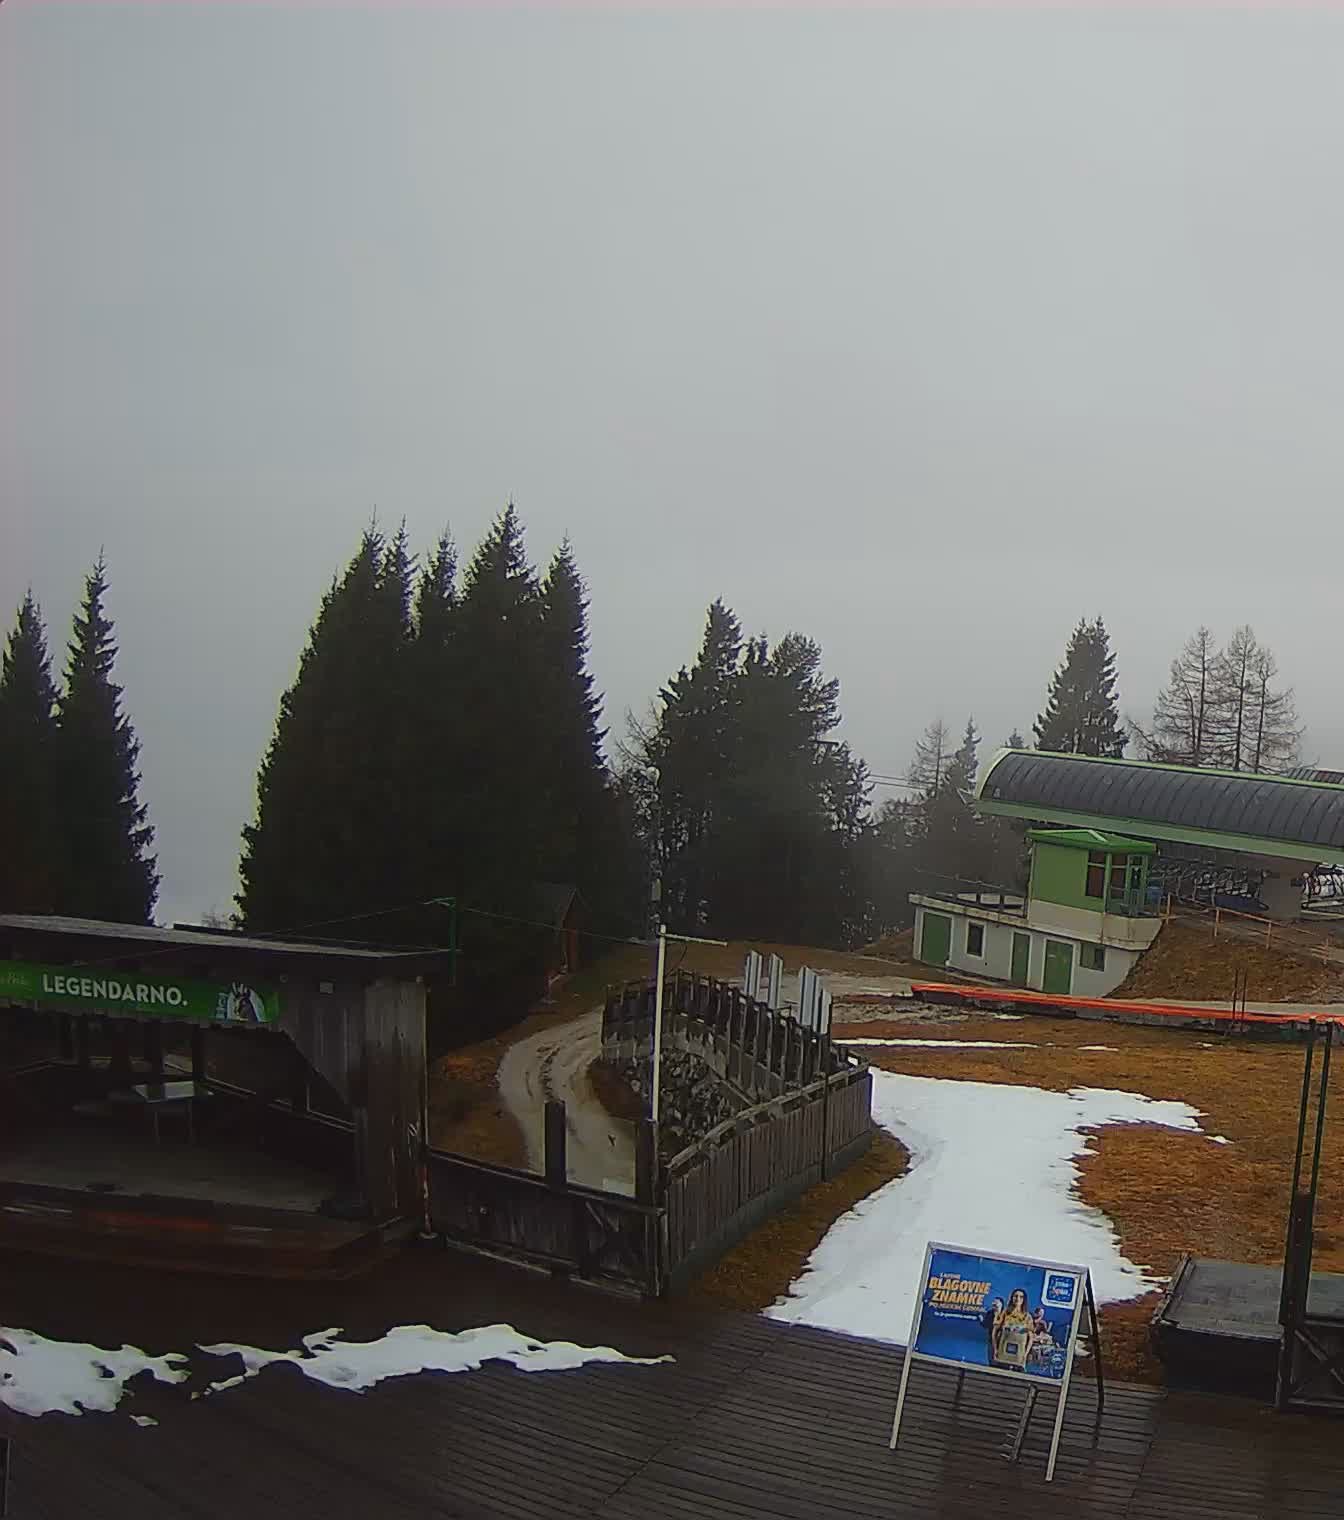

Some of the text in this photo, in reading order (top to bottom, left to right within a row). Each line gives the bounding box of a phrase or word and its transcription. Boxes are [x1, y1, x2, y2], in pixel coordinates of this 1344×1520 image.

[43, 973, 188, 1006] LEGENDARNO.
[929, 1277, 992, 1294] BLAGOVNE
[931, 1290, 985, 1306] ZNAMKE
